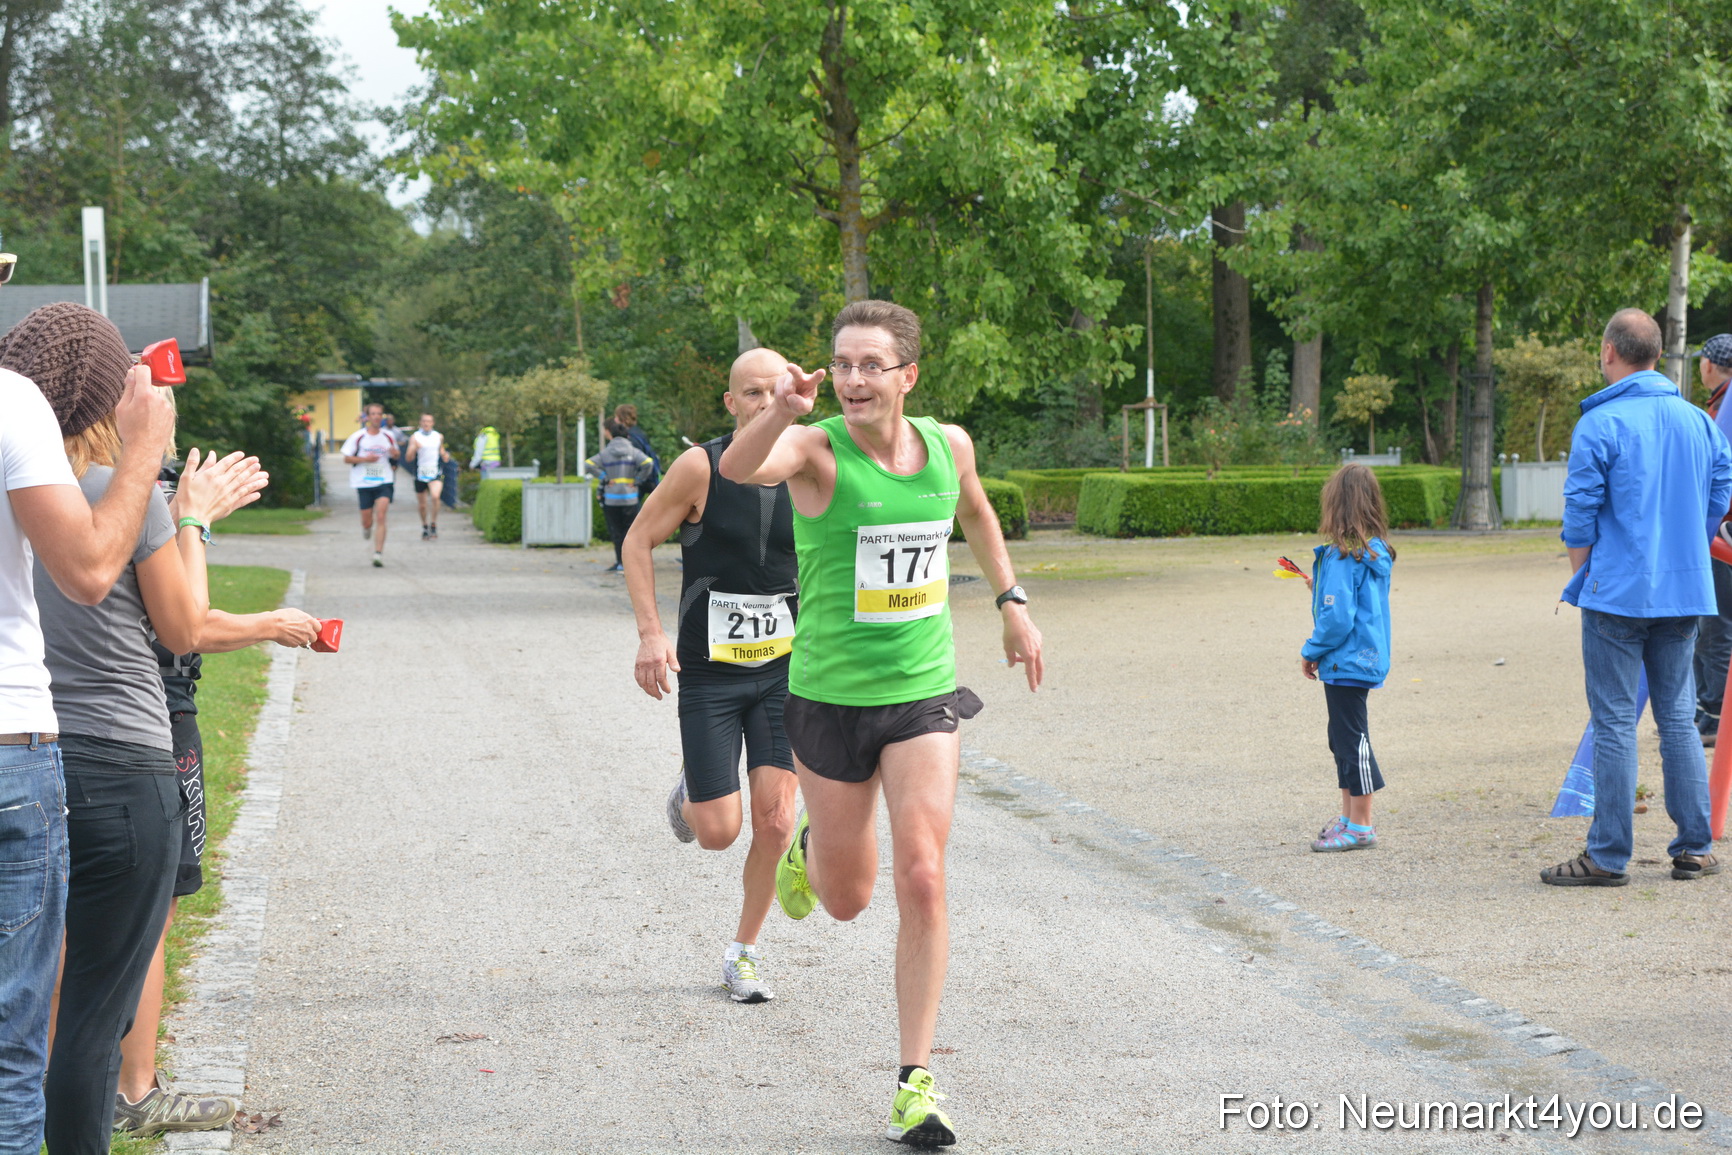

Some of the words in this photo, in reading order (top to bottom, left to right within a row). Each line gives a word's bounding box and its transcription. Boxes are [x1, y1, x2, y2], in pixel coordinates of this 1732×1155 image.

[860, 535, 895, 544] PARTL
[897, 531, 943, 542] Neumarkt
[880, 544, 938, 584] 177
[711, 599, 741, 609] PARTL
[888, 592, 927, 608] Martin
[727, 612, 778, 639] 210
[732, 646, 775, 659] Thomas
